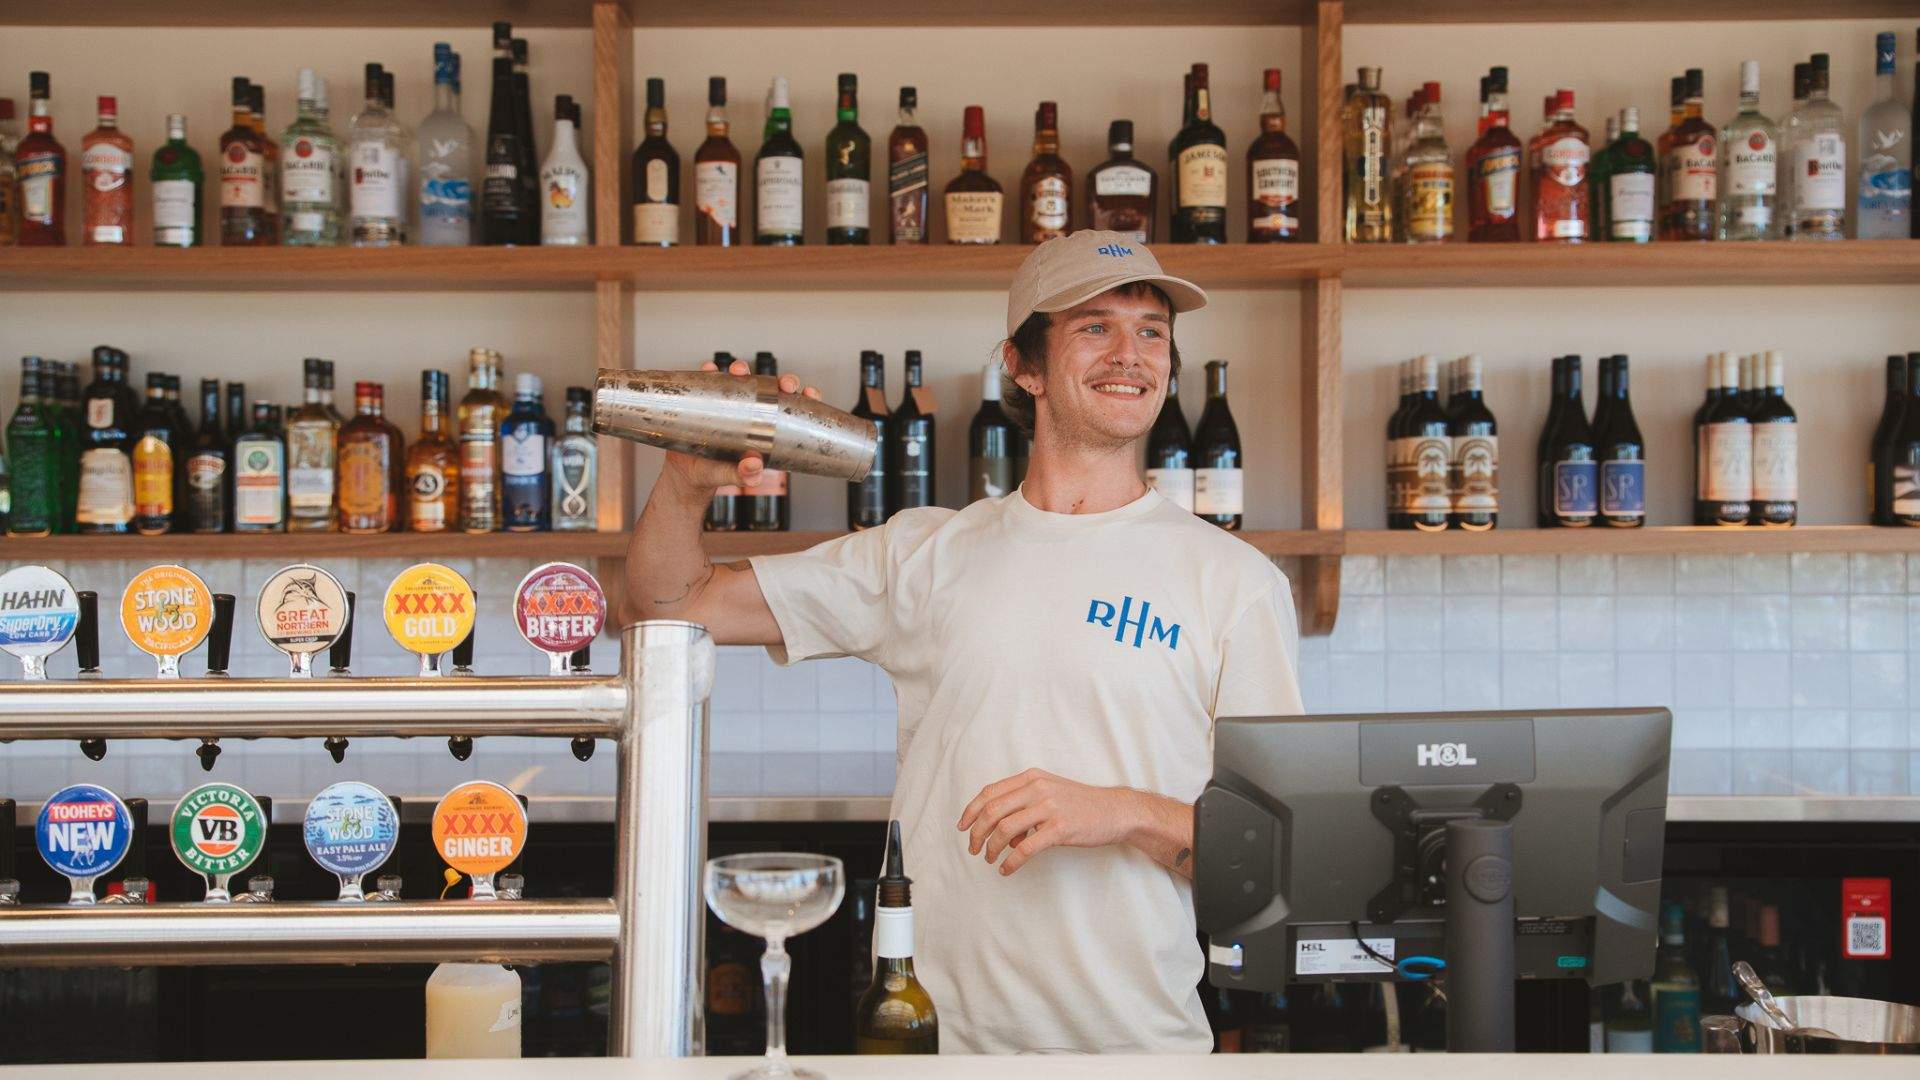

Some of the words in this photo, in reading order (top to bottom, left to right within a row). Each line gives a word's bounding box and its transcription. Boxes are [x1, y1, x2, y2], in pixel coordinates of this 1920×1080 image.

[1, 589, 65, 610] HAHN
[135, 587, 197, 611] STONE
[394, 592, 466, 614] XXXX
[525, 591, 598, 615] XXXX
[138, 612, 197, 632] WOOD
[276, 608, 328, 622] GREAT
[276, 620, 329, 631] NORTHERN
[1085, 595, 1181, 651] RHM
[404, 616, 457, 637] GOLD
[526, 615, 596, 638] BITTER
[1417, 742, 1477, 767] H&L
[53, 804, 113, 820] TOOHEYS
[181, 790, 255, 822] VICTORIA
[326, 806, 375, 824] STONE
[197, 818, 238, 841] VB
[327, 825, 375, 842] WOOD
[442, 812, 516, 835] XXXX
[49, 821, 116, 853] NEW
[444, 836, 513, 858] GINGER
[185, 847, 249, 870] BITTER
[317, 846, 342, 855] EASY
[342, 844, 367, 853] PALE
[368, 843, 387, 852] ALE
